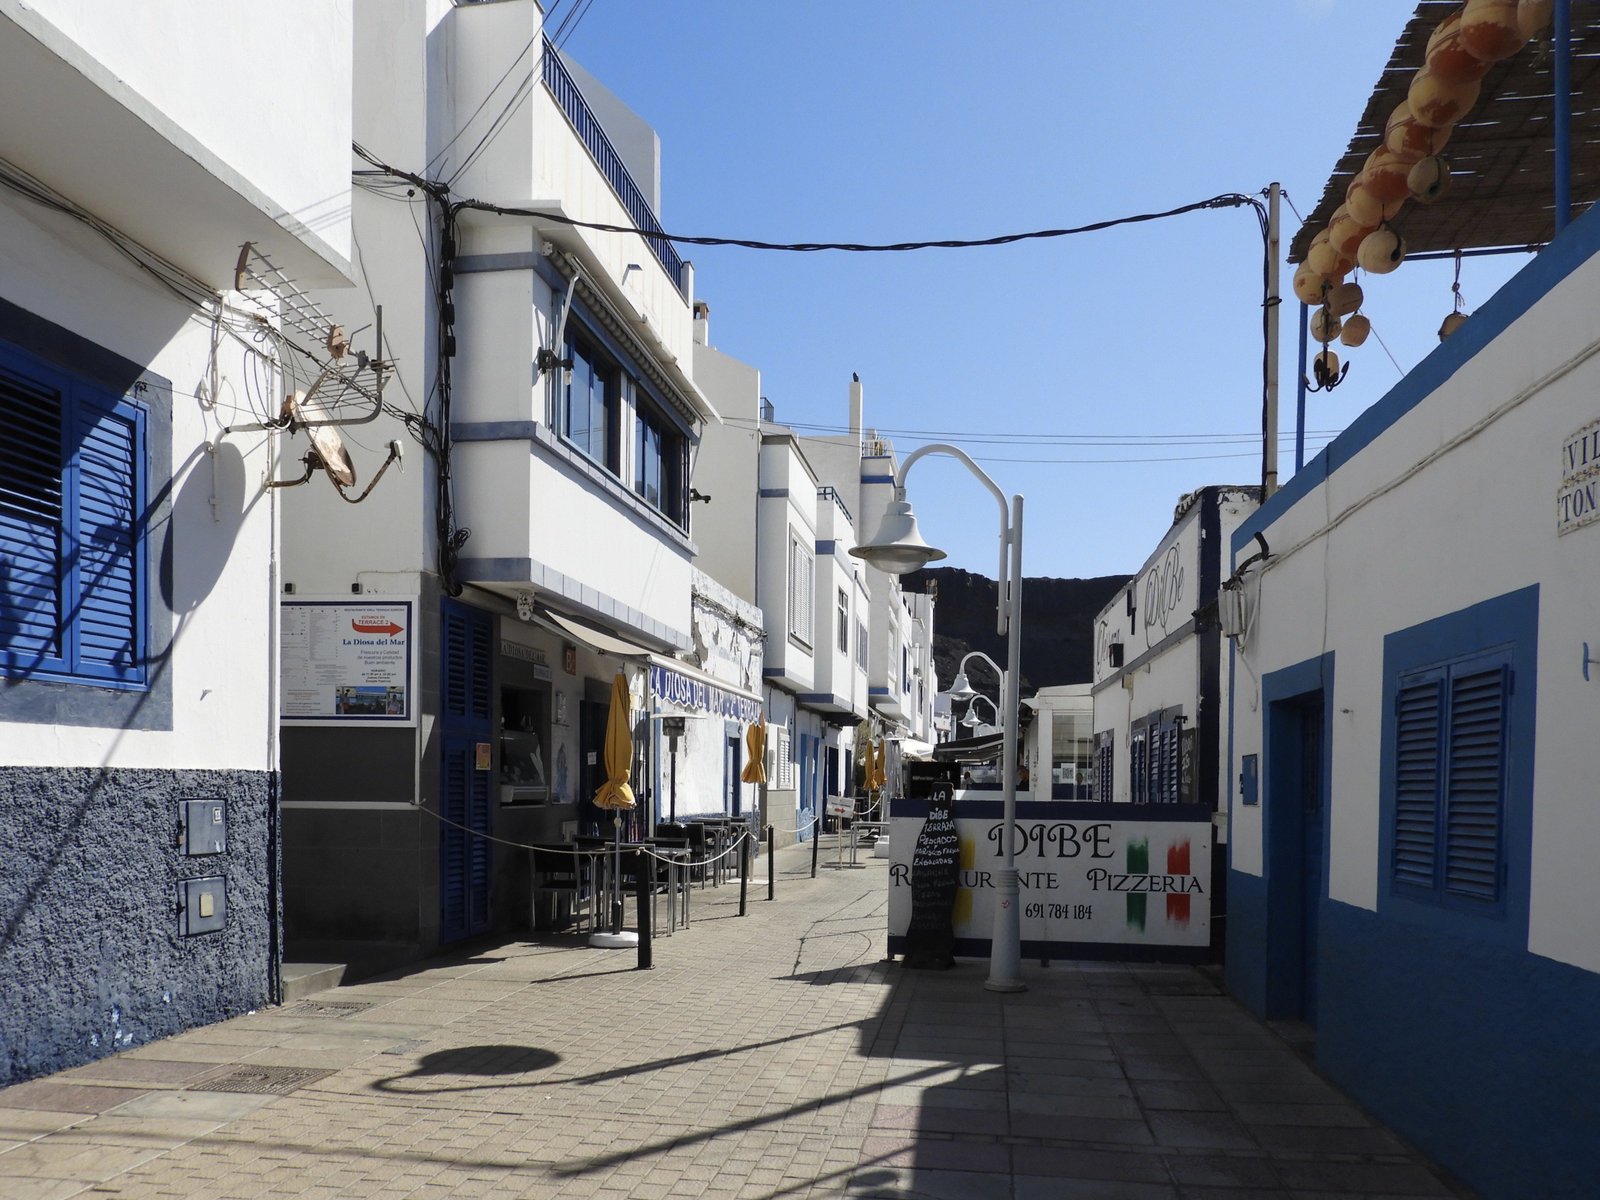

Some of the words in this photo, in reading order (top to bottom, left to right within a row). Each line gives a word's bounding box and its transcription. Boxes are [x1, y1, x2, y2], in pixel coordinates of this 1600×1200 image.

[1561, 481, 1596, 523] TON
[650, 667, 661, 695] LA
[665, 672, 692, 703] DIOSA
[693, 680, 707, 708] DEL
[709, 685, 724, 713] MAR
[932, 790, 946, 801] LA
[924, 820, 955, 833] TERRAZA
[919, 834, 958, 845] PESCADOS
[988, 823, 1115, 859] DIBE
[1086, 868, 1204, 893] PIZZERIA
[1025, 903, 1044, 919] 691
[1048, 903, 1070, 920] 784
[1073, 904, 1093, 920] 184
